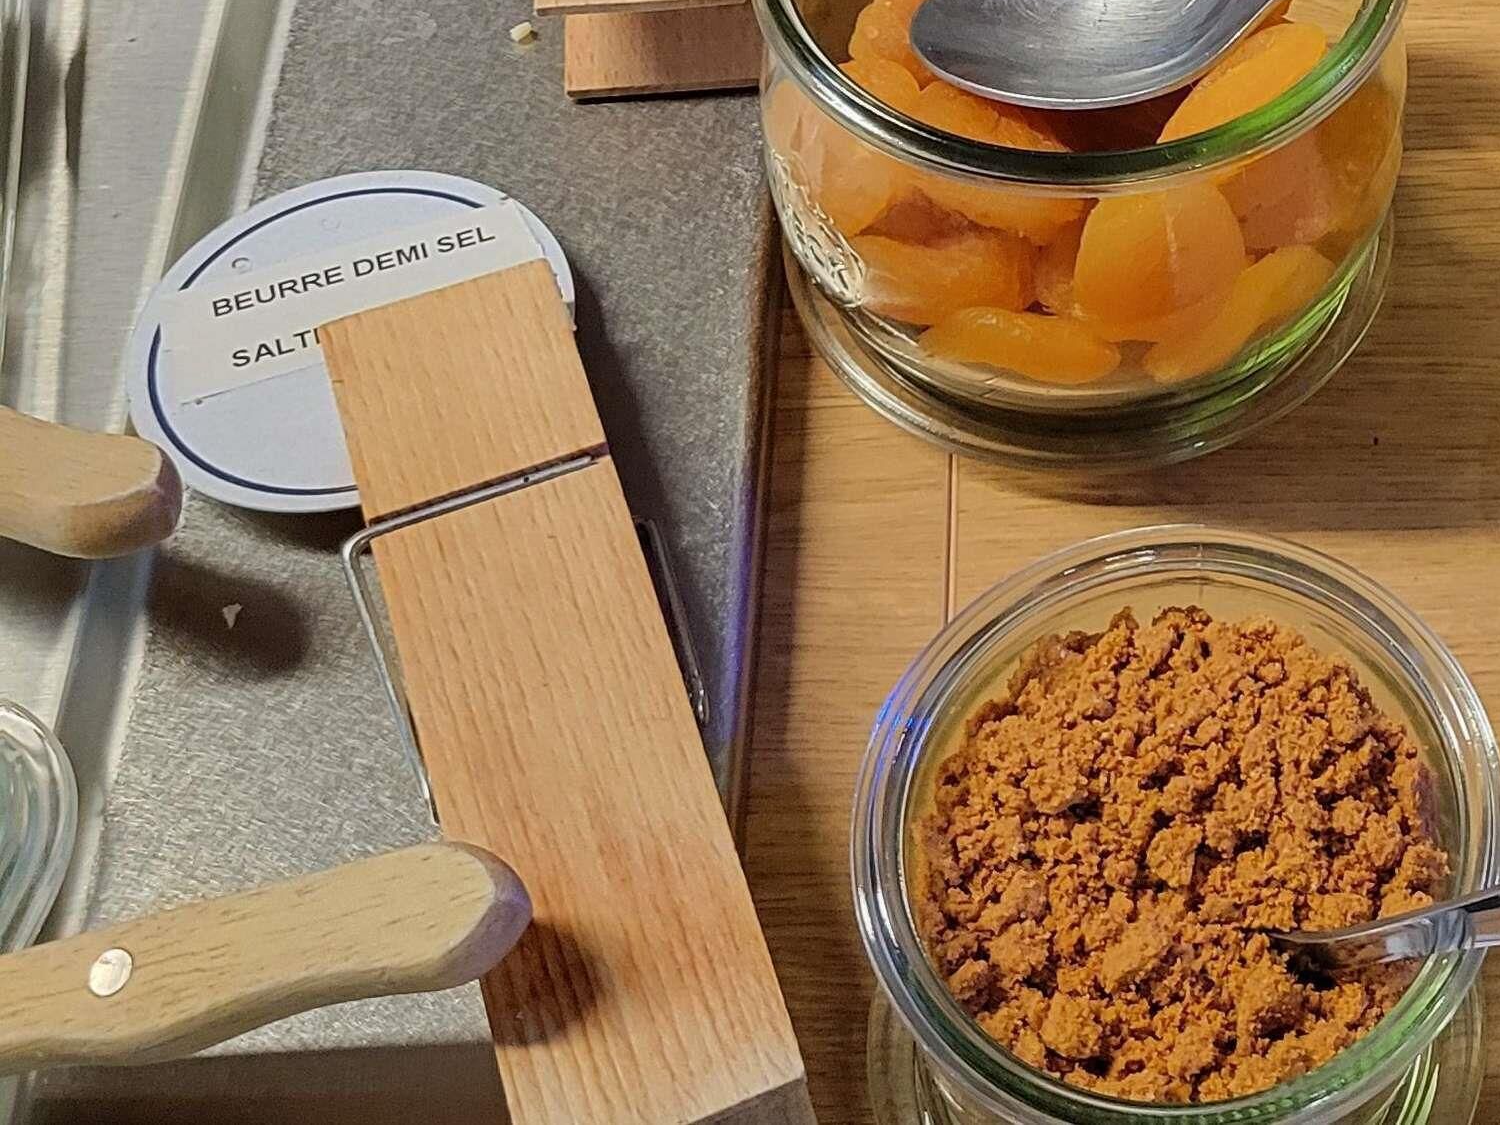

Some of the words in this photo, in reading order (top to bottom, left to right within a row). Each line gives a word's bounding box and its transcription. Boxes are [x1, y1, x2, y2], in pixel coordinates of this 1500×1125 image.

[212, 264, 343, 317] BEURRE
[353, 242, 430, 278] DEMI
[436, 225, 496, 254] SEL
[231, 327, 320, 367] SALT
